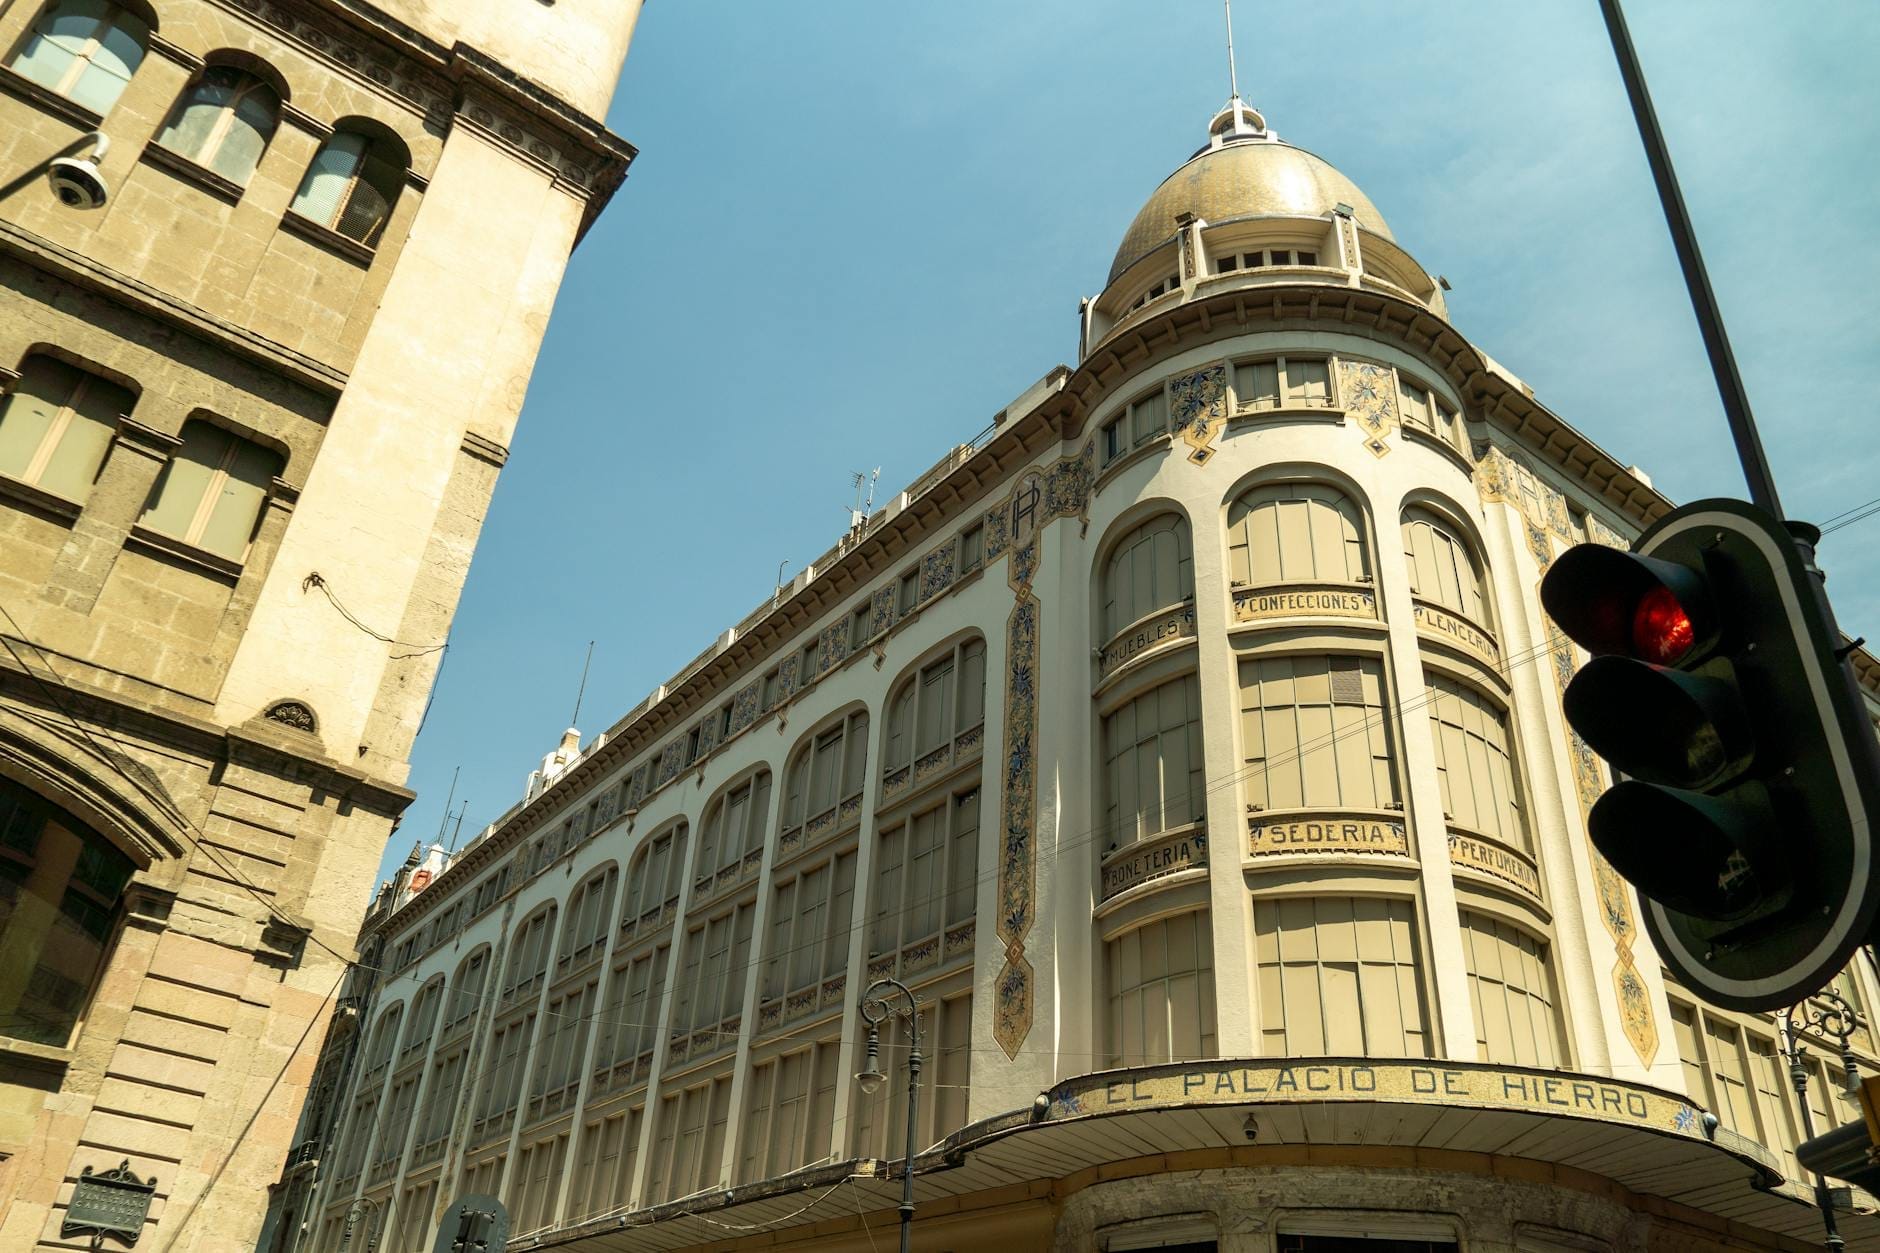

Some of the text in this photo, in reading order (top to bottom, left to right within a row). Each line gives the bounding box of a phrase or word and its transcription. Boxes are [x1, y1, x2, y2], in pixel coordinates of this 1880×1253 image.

[1250, 594, 1360, 612] CONFECCIONES
[1110, 620, 1177, 666] MUEBLES
[1427, 611, 1494, 659] LENCERIA
[1270, 824, 1385, 844] SEDERIA
[1112, 842, 1190, 886] BONETERIA
[1460, 840, 1534, 887] PERFUMERIA
[1106, 1066, 1647, 1119] EL PALACIO DE HIERRO
